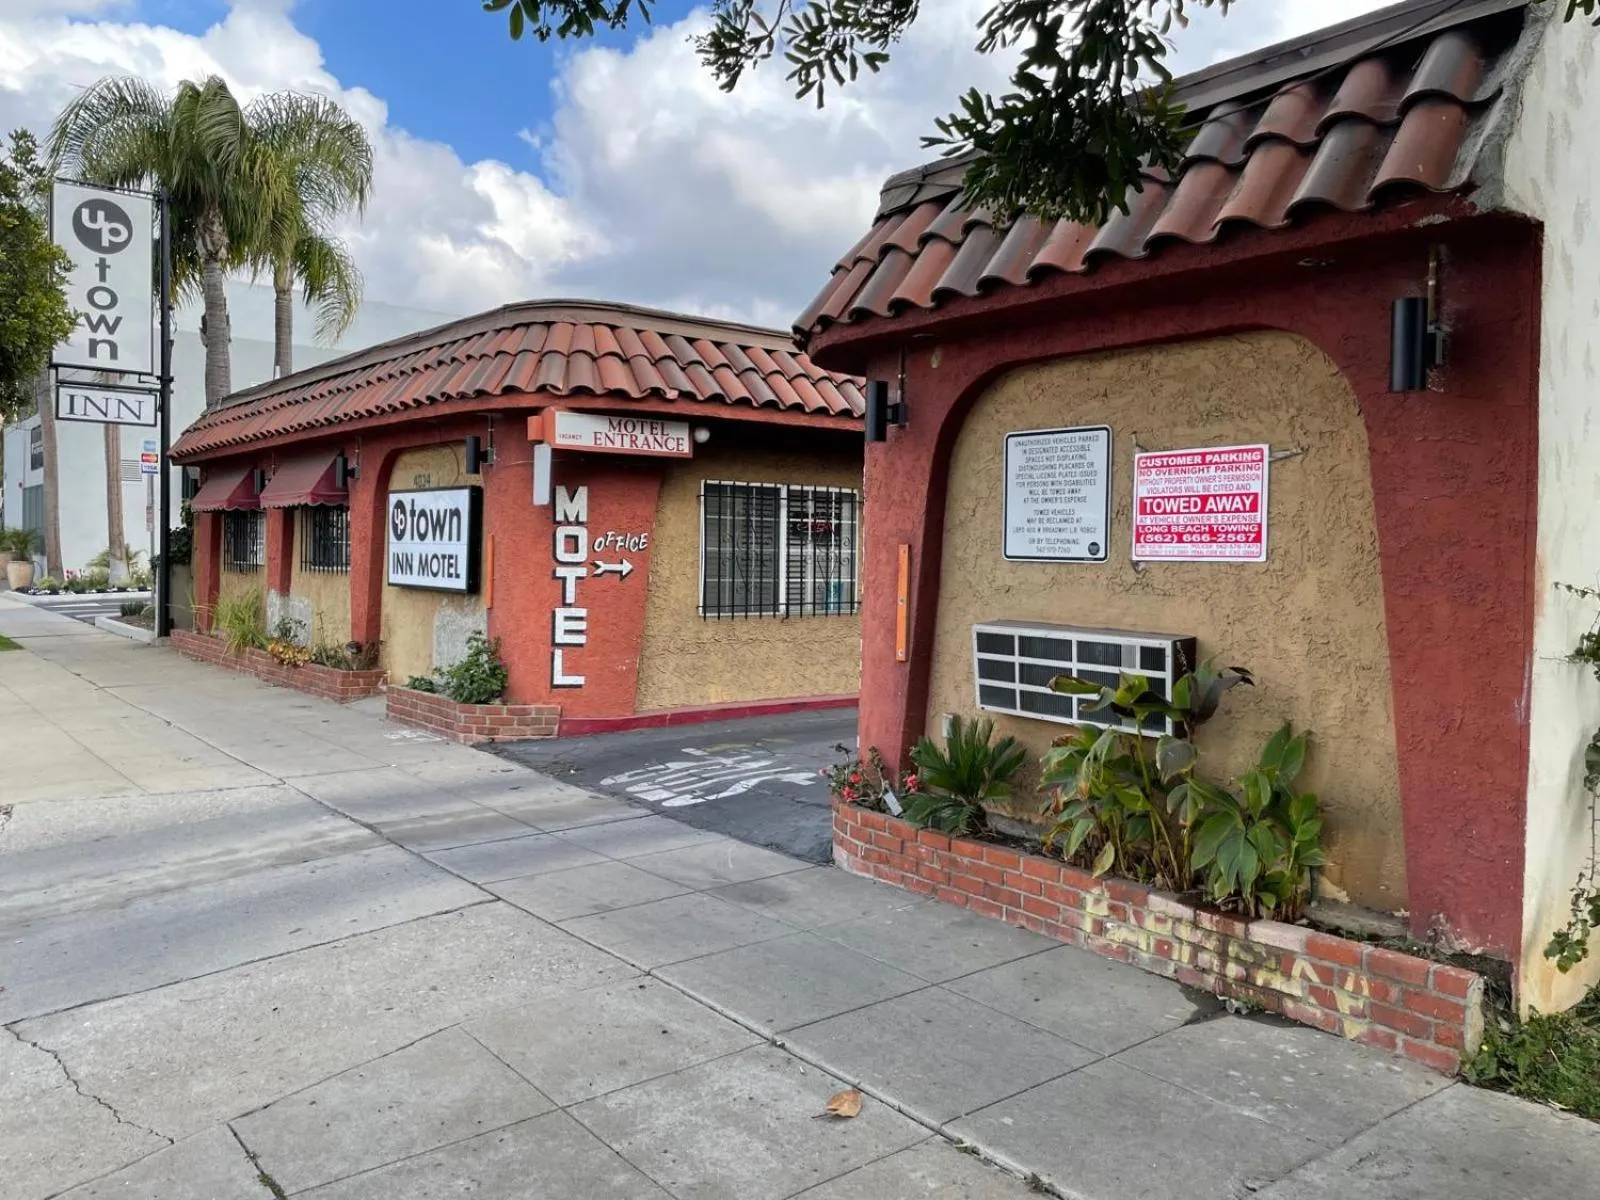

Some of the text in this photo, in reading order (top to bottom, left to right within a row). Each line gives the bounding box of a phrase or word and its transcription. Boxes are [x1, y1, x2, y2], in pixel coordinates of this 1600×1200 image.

[81, 208, 129, 247] up
[65, 393, 145, 421] INN
[608, 417, 670, 436] MOTEL
[592, 431, 685, 452] ENTRANCE
[1140, 452, 1261, 467] CUSTOMER PARKING
[1155, 466, 1211, 476] OVERNIGHT
[1215, 464, 1260, 474] PARKING
[1140, 474, 1260, 486] WITHOUT PROPERTY OWNER'S PERMISSION
[1147, 483, 1251, 494] VIOLATORS WILL BE CITED AND
[1144, 495, 1254, 513] TOWED AWAY
[409, 498, 462, 542] town
[1183, 515, 1219, 523] OWNER'S
[1222, 515, 1259, 523] EXPENSE
[592, 531, 649, 553] OFFICE
[1140, 533, 1256, 543] (562) 666-2567
[392, 552, 461, 579] INN MOTEL
[552, 485, 588, 688] MOTEL
